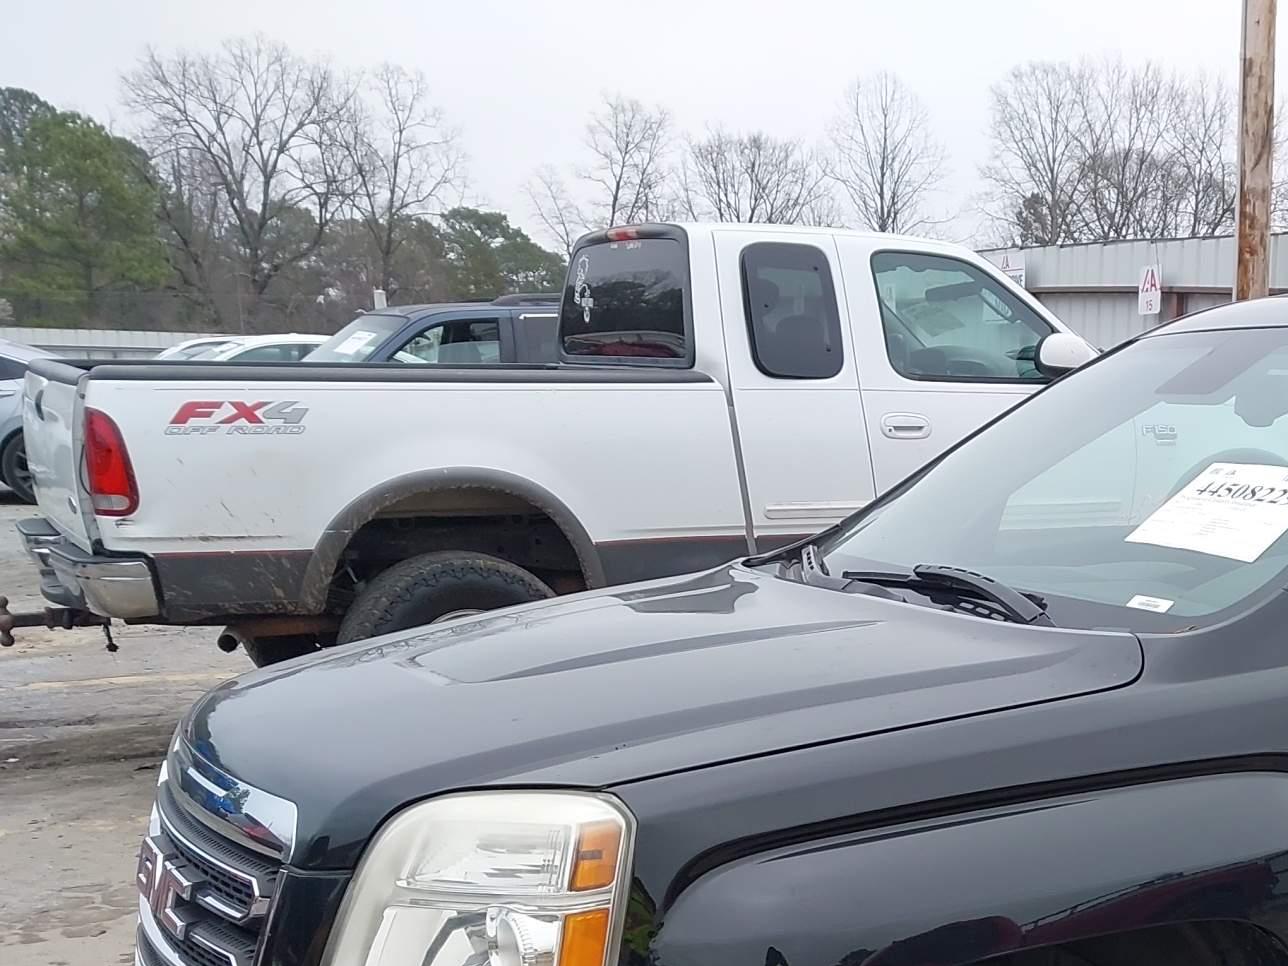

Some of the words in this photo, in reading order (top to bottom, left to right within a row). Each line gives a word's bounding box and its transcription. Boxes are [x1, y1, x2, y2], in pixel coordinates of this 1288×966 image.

[169, 401, 309, 424] FX4
[164, 426, 221, 435] OFF
[225, 425, 306, 435] ROAD
